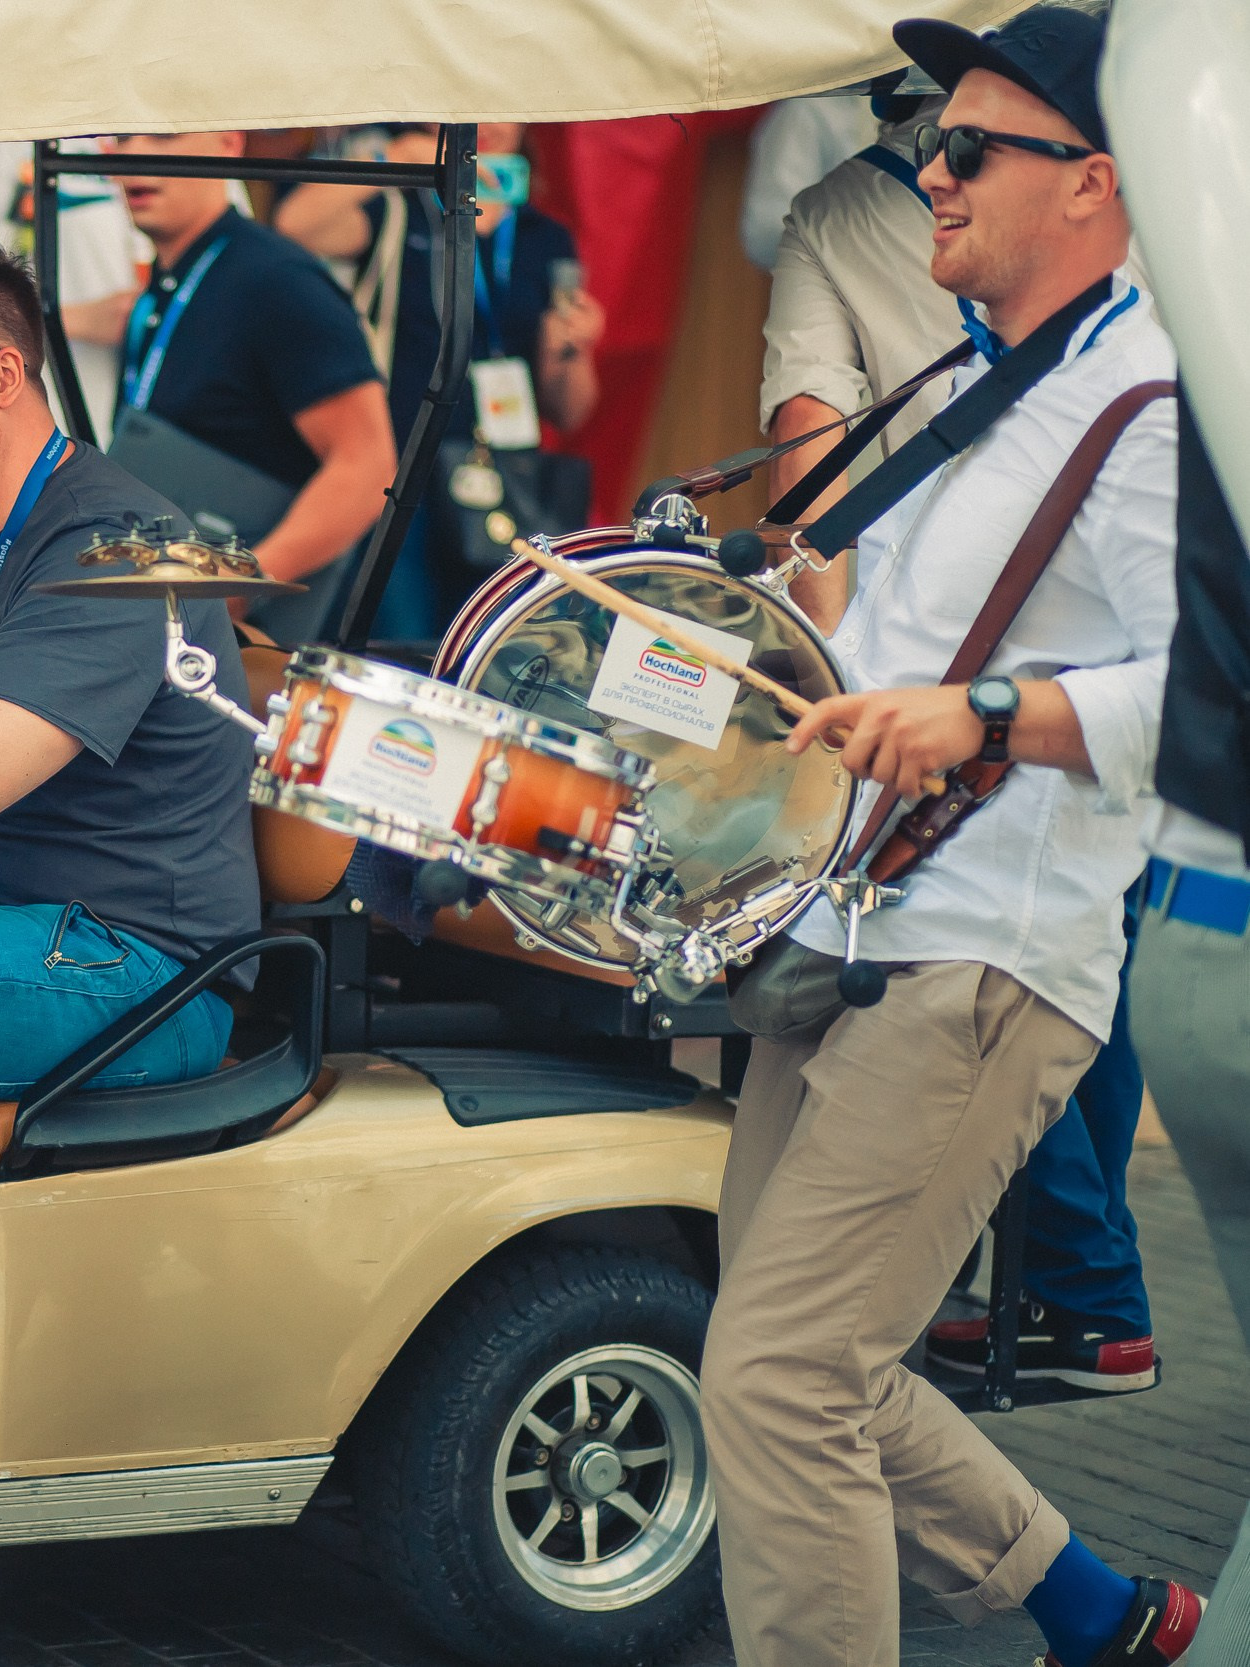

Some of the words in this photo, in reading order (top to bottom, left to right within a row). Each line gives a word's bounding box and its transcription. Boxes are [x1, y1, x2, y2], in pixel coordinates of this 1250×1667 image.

[644, 655, 702, 682] Hochland
[621, 682, 661, 700] ЭКСПЕРТ
[663, 696, 670, 704] В
[671, 699, 705, 716] СЫРАХ
[633, 672, 700, 700] PROFESSIONAL
[602, 687, 623, 700] ДЛЯ
[625, 694, 715, 732] ПРОФЕССИОНАЛОВ
[375, 742, 430, 769] Hochland
